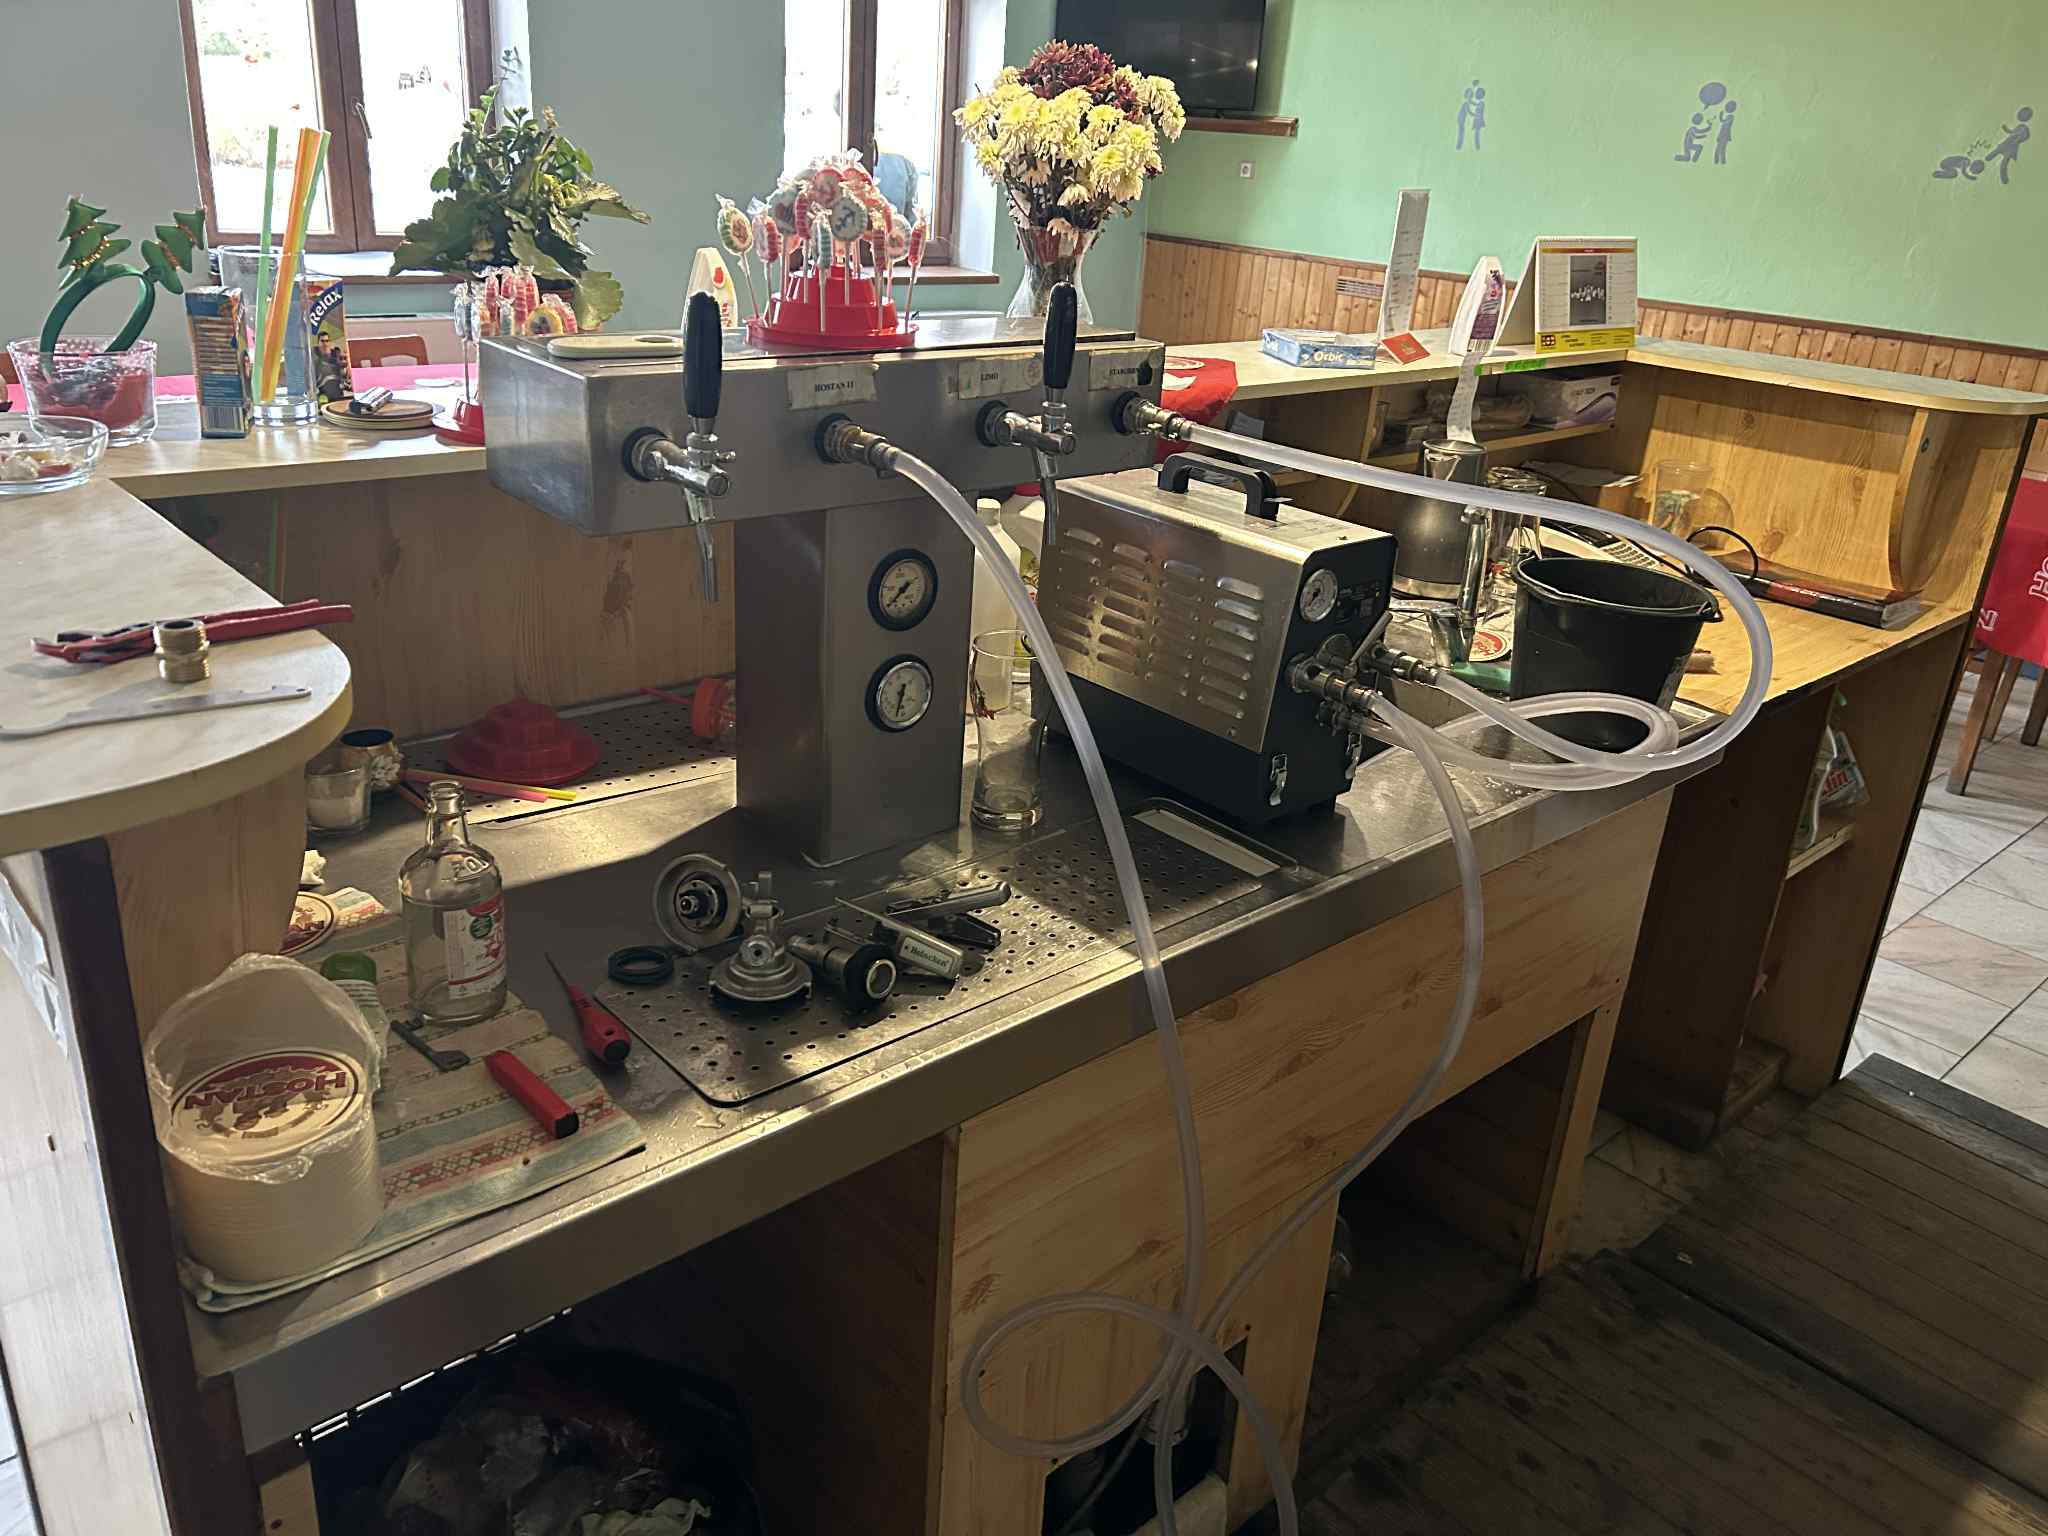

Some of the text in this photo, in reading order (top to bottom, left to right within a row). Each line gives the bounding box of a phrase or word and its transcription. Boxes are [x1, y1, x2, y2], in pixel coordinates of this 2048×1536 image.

[309, 291, 342, 327] Relax
[815, 381, 844, 392] HOSTAN
[910, 945, 947, 967] Heineken
[184, 1071, 347, 1110] HOSTAN
